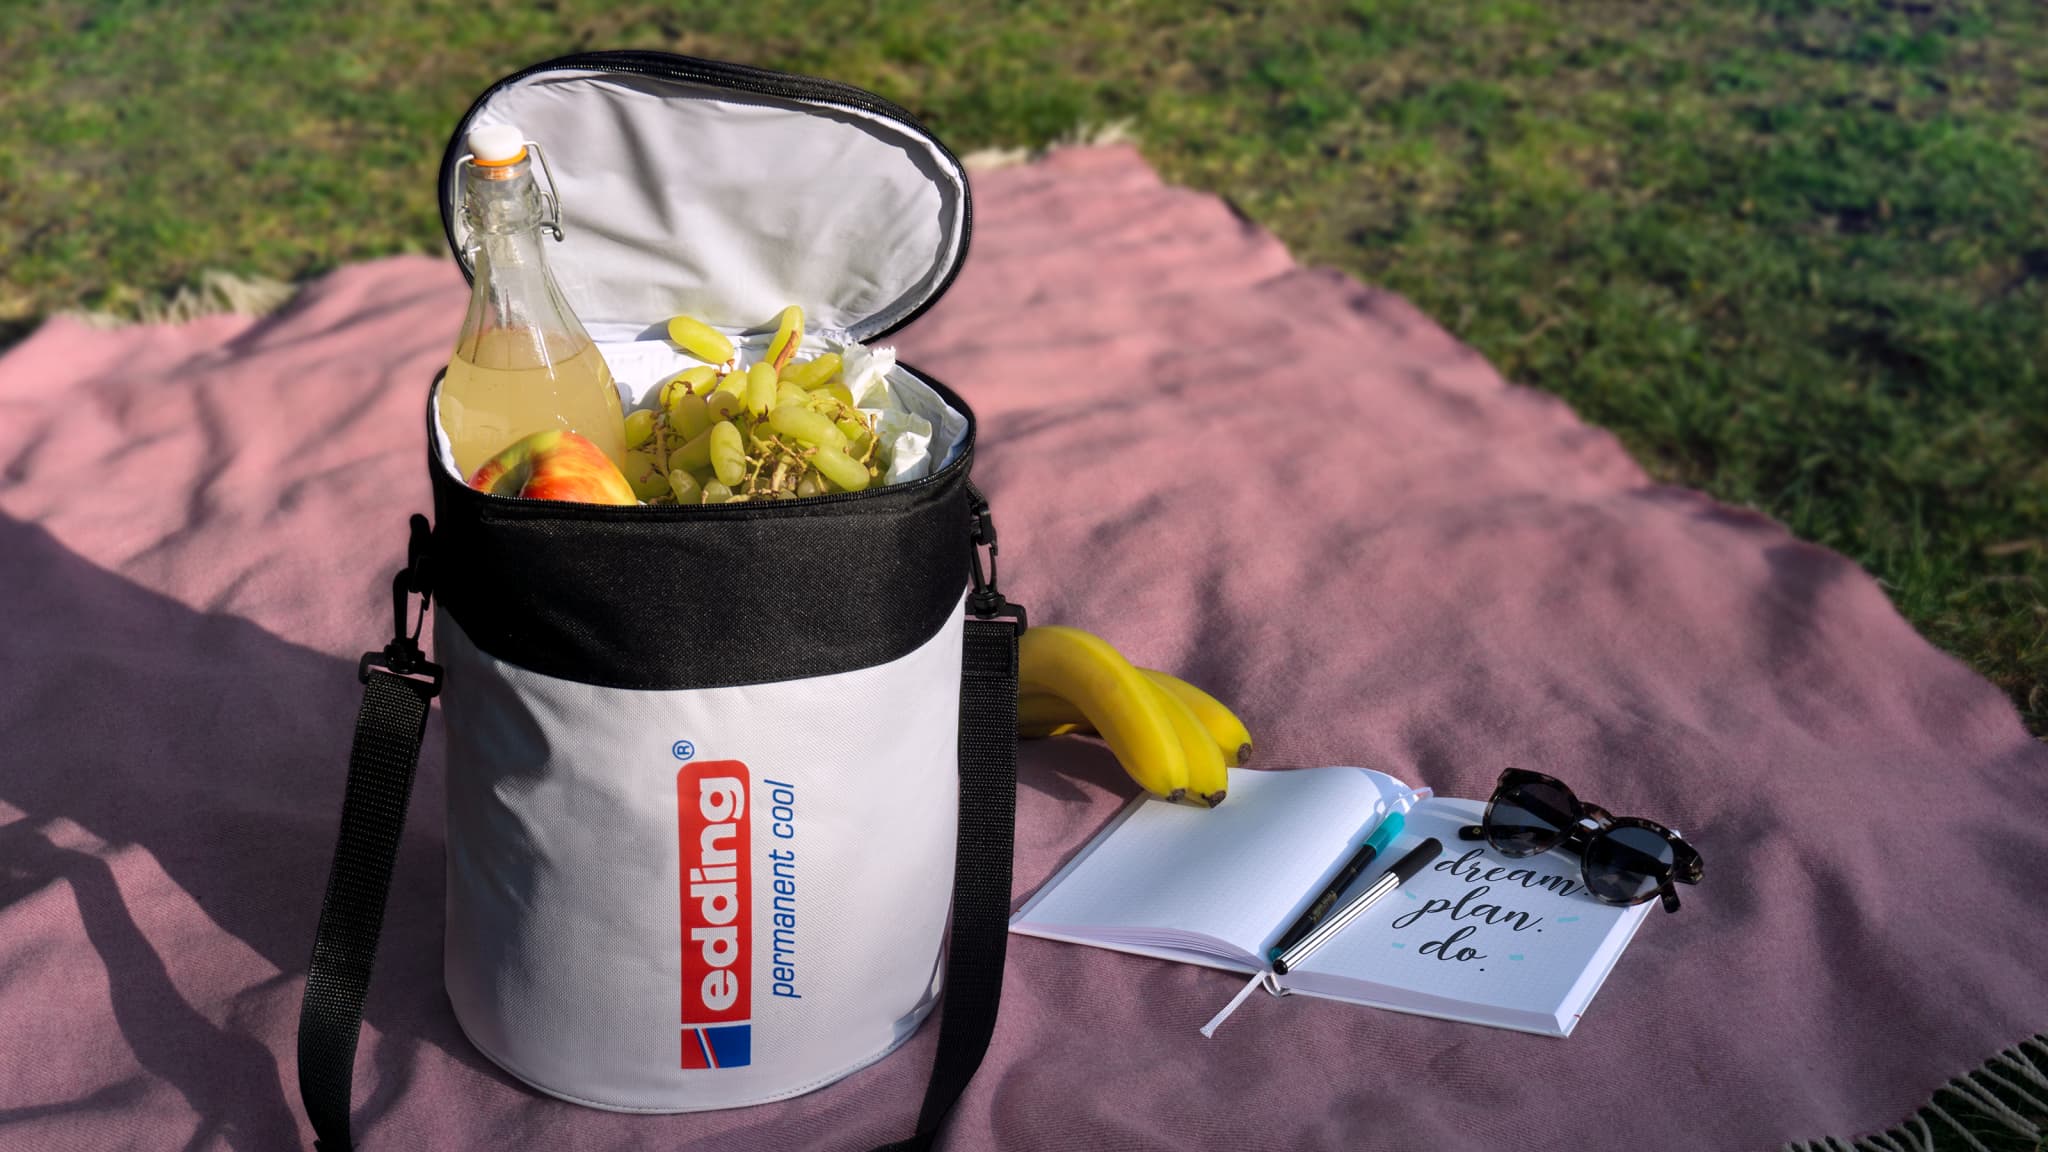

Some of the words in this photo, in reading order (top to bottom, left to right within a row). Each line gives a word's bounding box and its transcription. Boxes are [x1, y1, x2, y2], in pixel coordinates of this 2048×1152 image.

[763, 779, 795, 839] cool
[690, 777, 744, 1011] edding
[1434, 848, 1589, 897] dream.
[769, 849, 802, 998] permanent
[1392, 885, 1543, 933] plan.
[1418, 925, 1488, 972] do.
